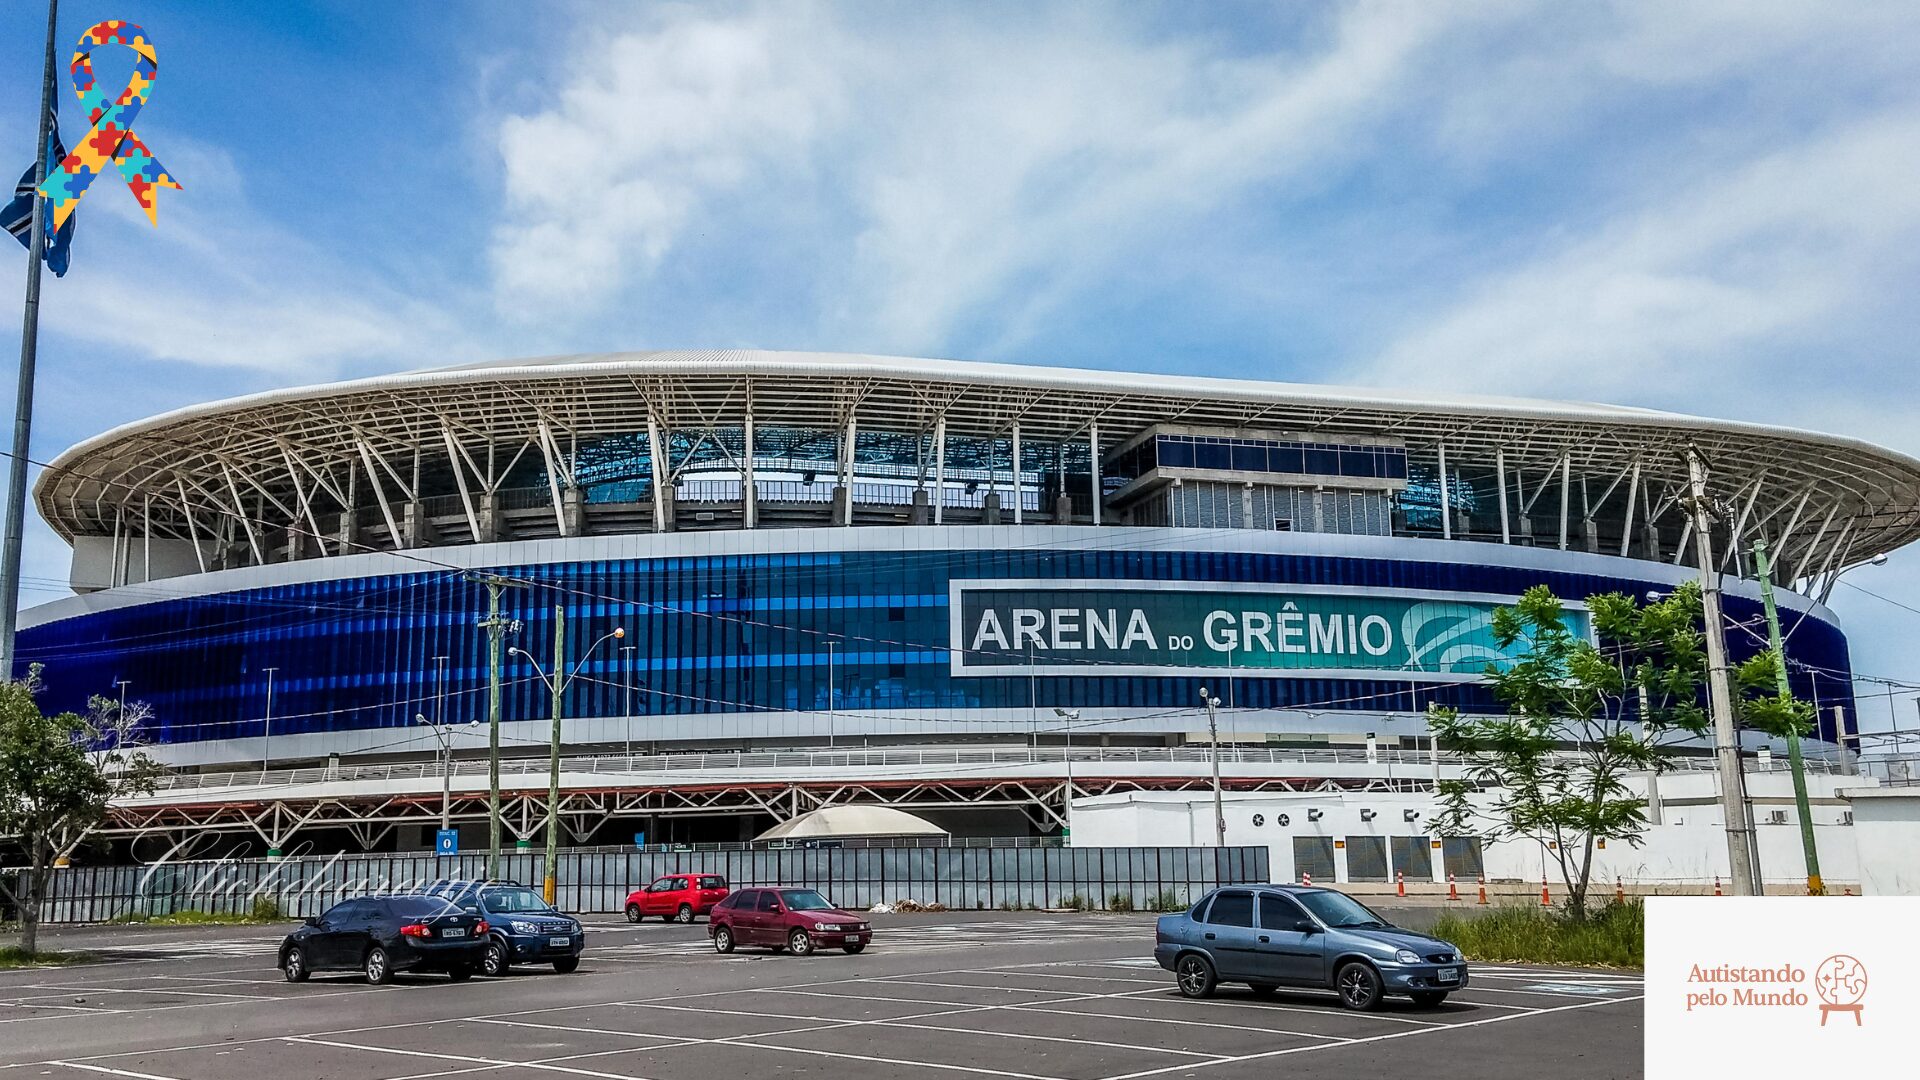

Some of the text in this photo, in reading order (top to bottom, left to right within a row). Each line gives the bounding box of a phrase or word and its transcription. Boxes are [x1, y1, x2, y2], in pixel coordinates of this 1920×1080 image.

[971, 601, 1393, 656] ARENA DO GRÊMIO
